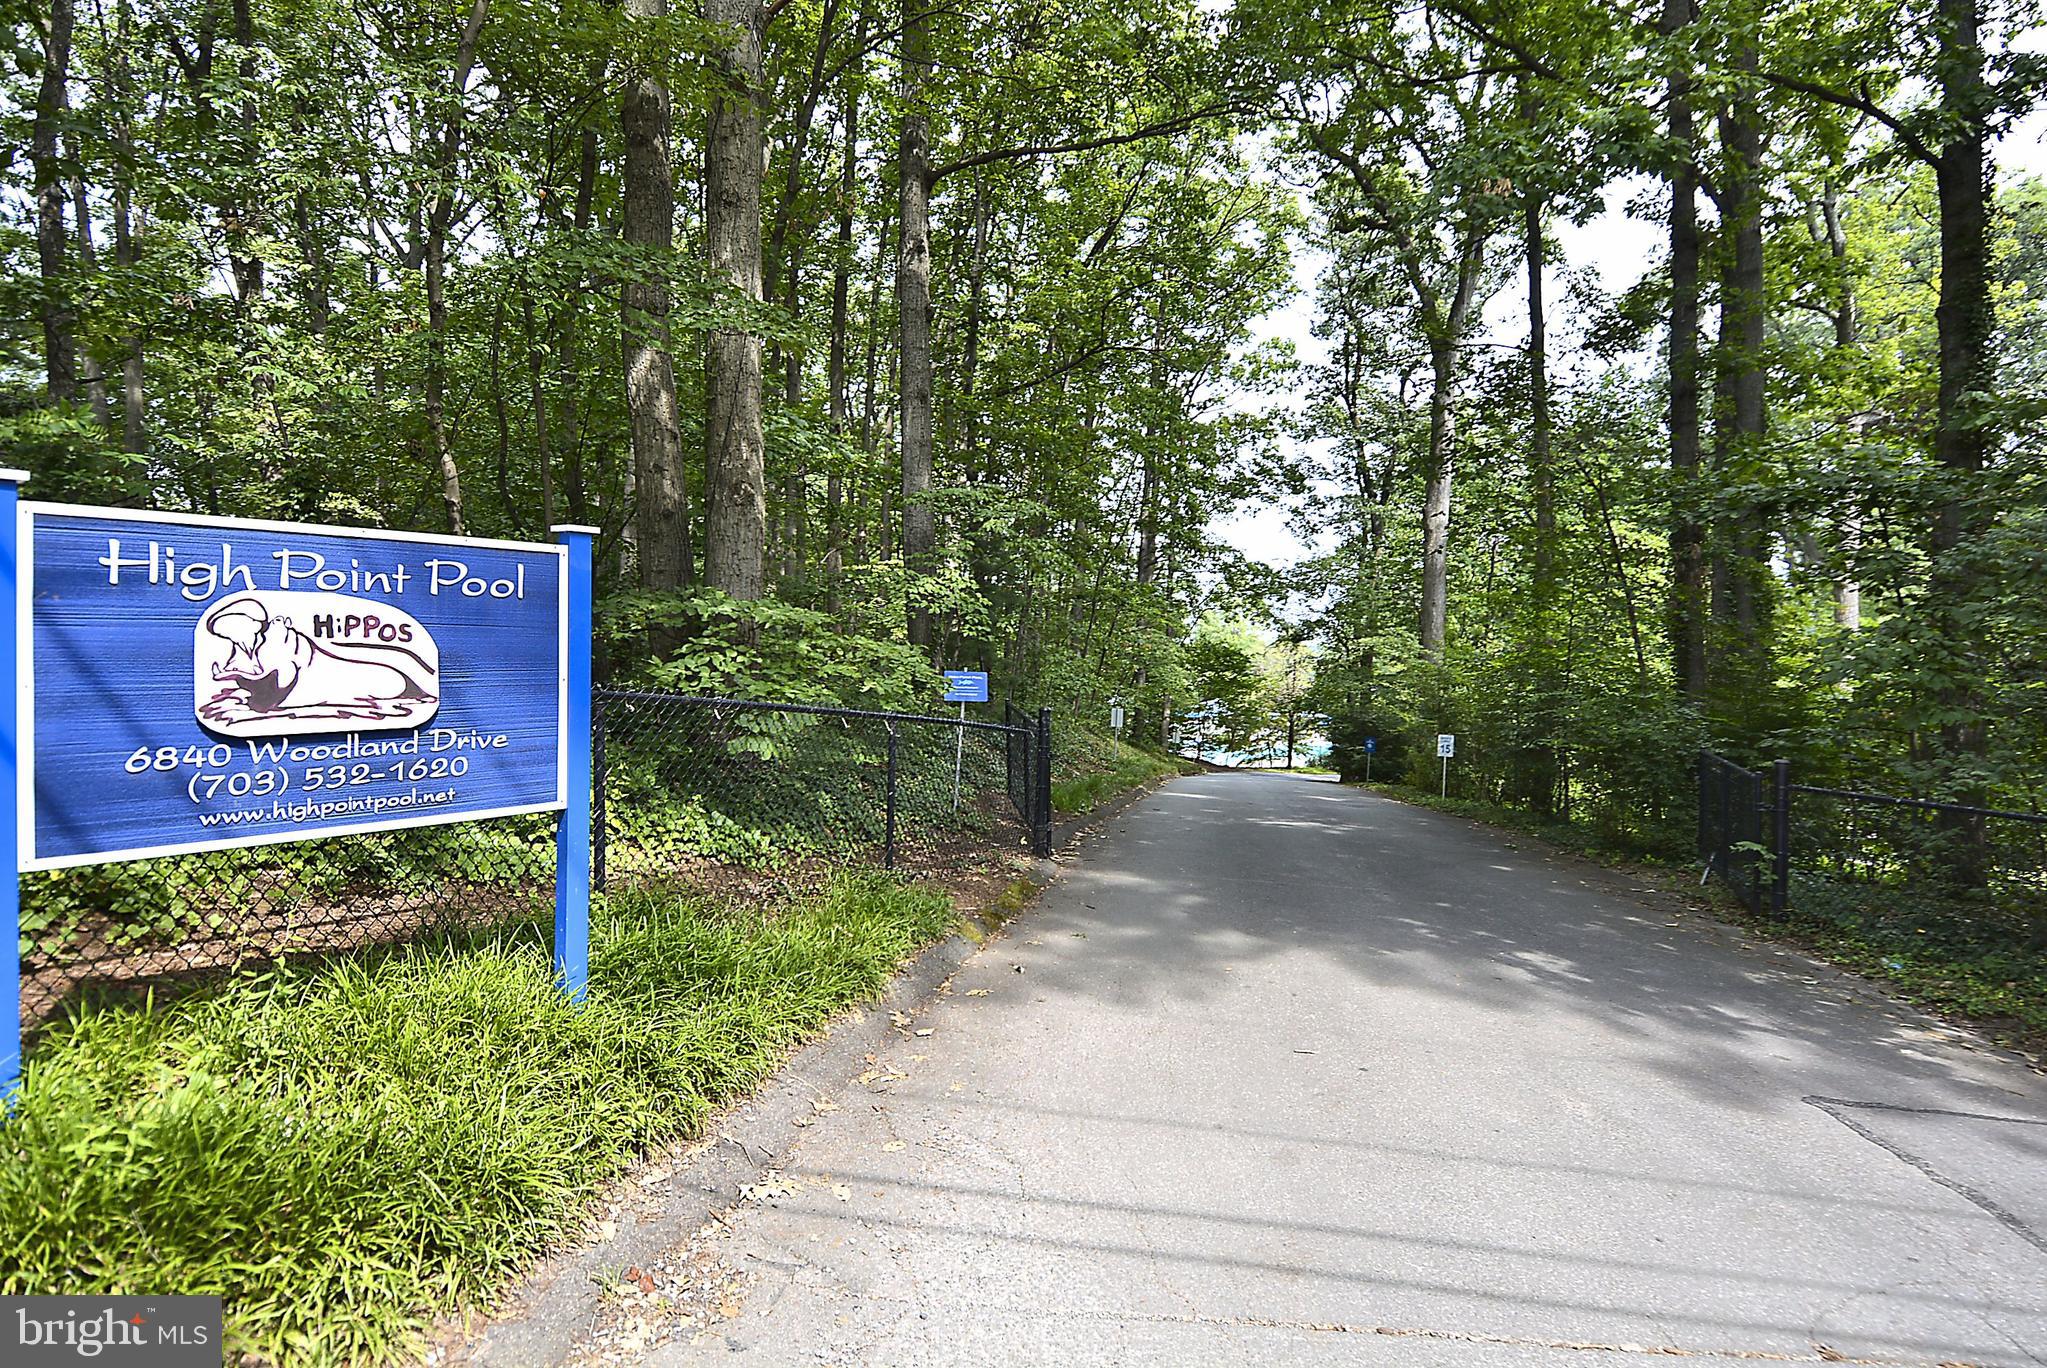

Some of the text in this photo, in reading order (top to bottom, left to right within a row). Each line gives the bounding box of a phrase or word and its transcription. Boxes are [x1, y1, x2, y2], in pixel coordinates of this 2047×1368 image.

[98, 538, 525, 601] High Point Pool
[124, 728, 509, 774] 6840 Woodland Drive
[1440, 744, 1451, 754] 15
[187, 756, 469, 804] (703) 532-1620
[199, 787, 456, 827] www.highpointpool.net
